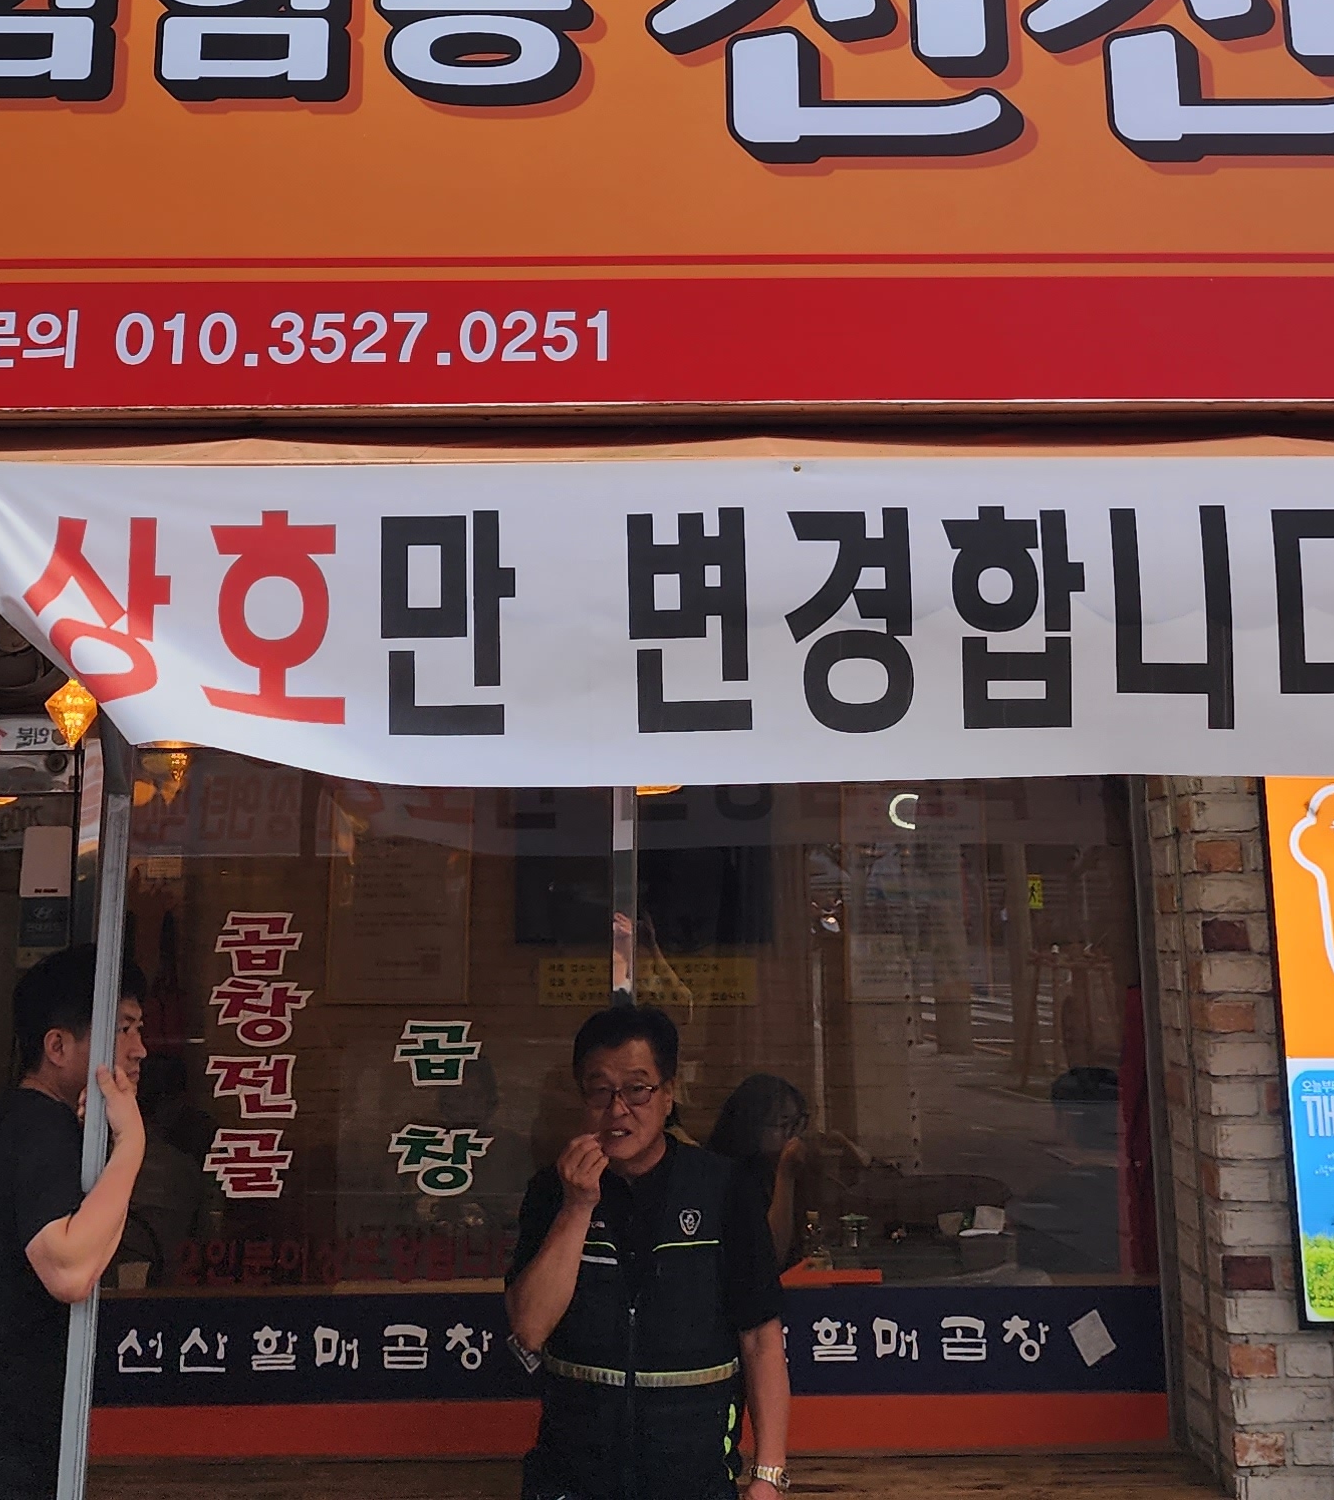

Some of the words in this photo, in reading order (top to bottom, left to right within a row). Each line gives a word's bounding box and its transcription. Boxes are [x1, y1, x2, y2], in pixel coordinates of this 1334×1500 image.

[114, 309, 612, 368] 010.3527.0251
[23, 507, 516, 738] 상호만
[202, 910, 315, 1200] 곱창전골
[387, 1018, 495, 1198] 곱창
